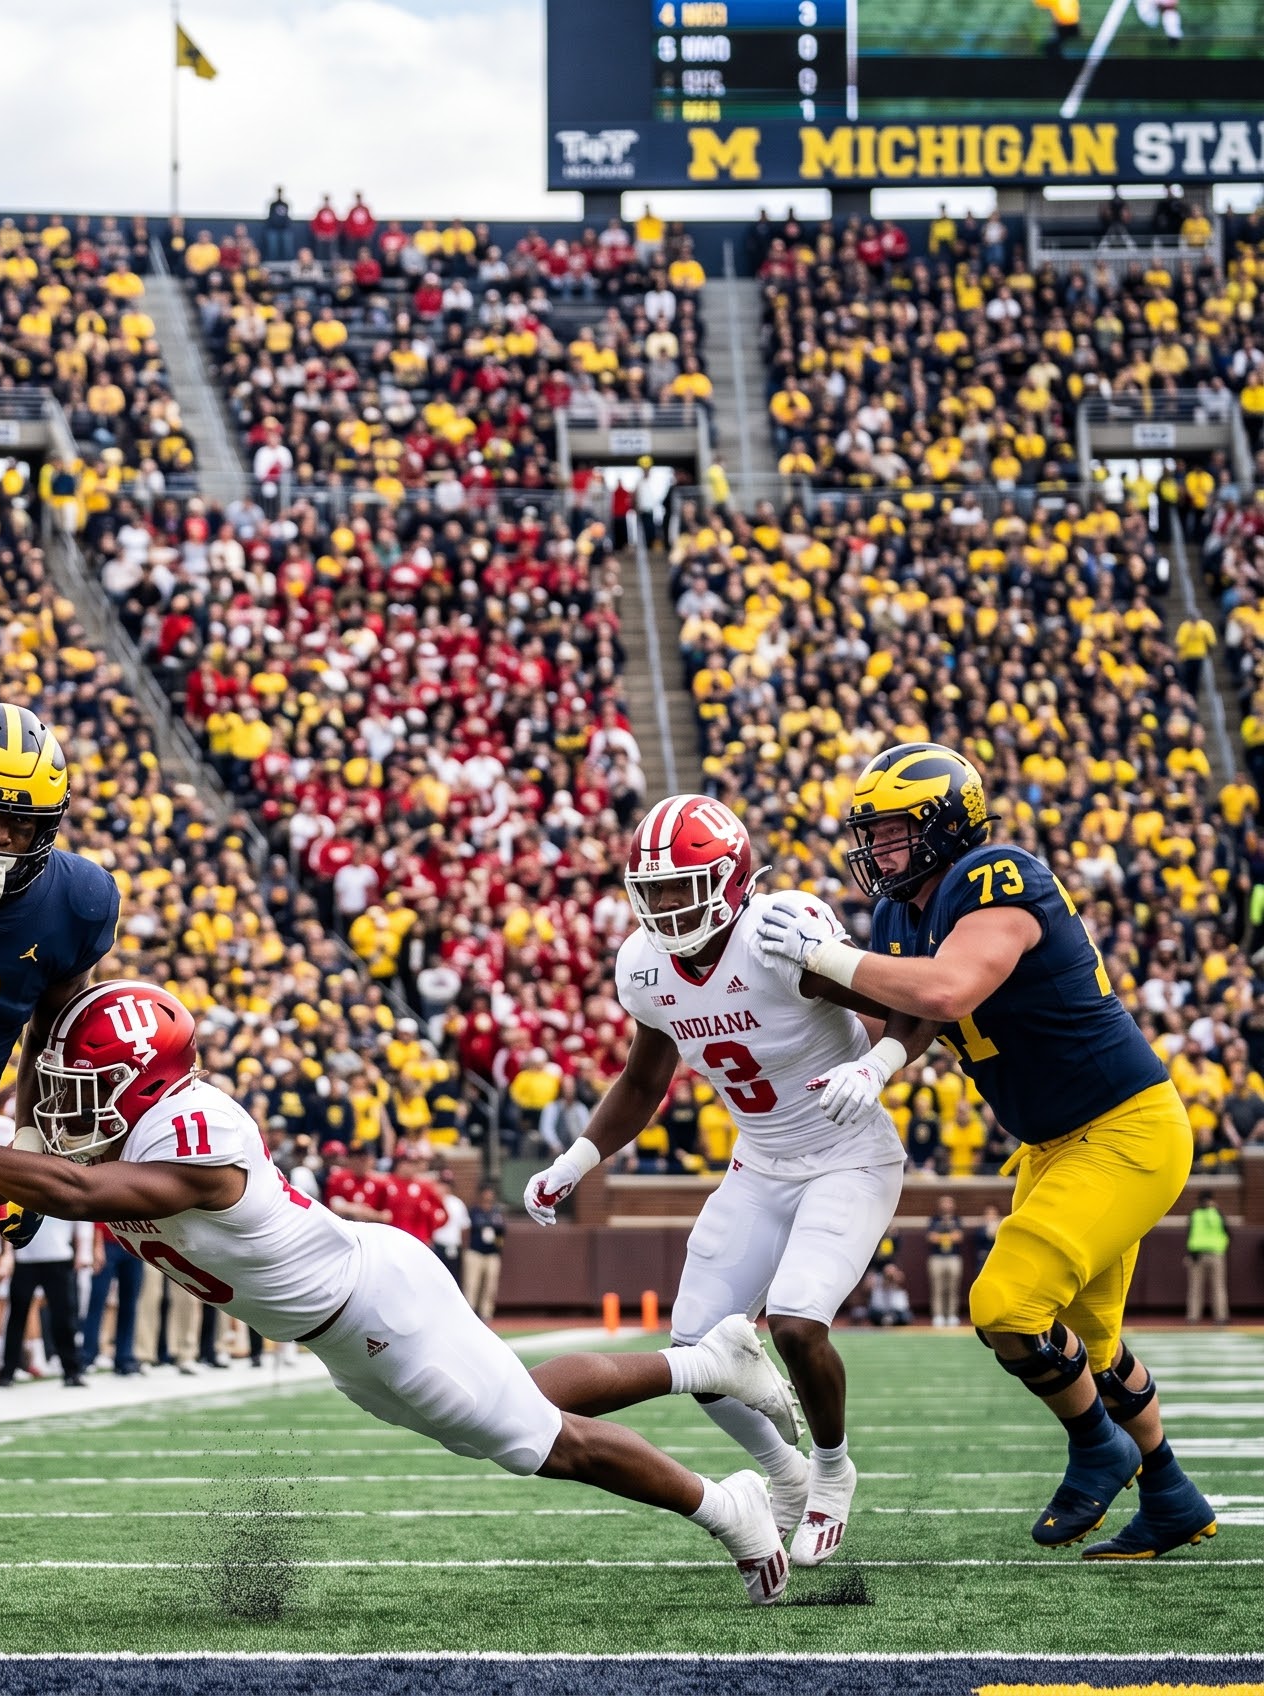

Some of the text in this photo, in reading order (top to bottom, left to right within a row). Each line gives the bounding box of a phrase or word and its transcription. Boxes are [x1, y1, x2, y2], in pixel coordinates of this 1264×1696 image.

[798, 0, 817, 27] 3
[688, 121, 1264, 181] M MICHIGAN STA
[967, 858, 1024, 905] 73
[669, 1010, 761, 1040] INDIANA
[702, 1040, 779, 1114] 3
[171, 1111, 212, 1158] 11
